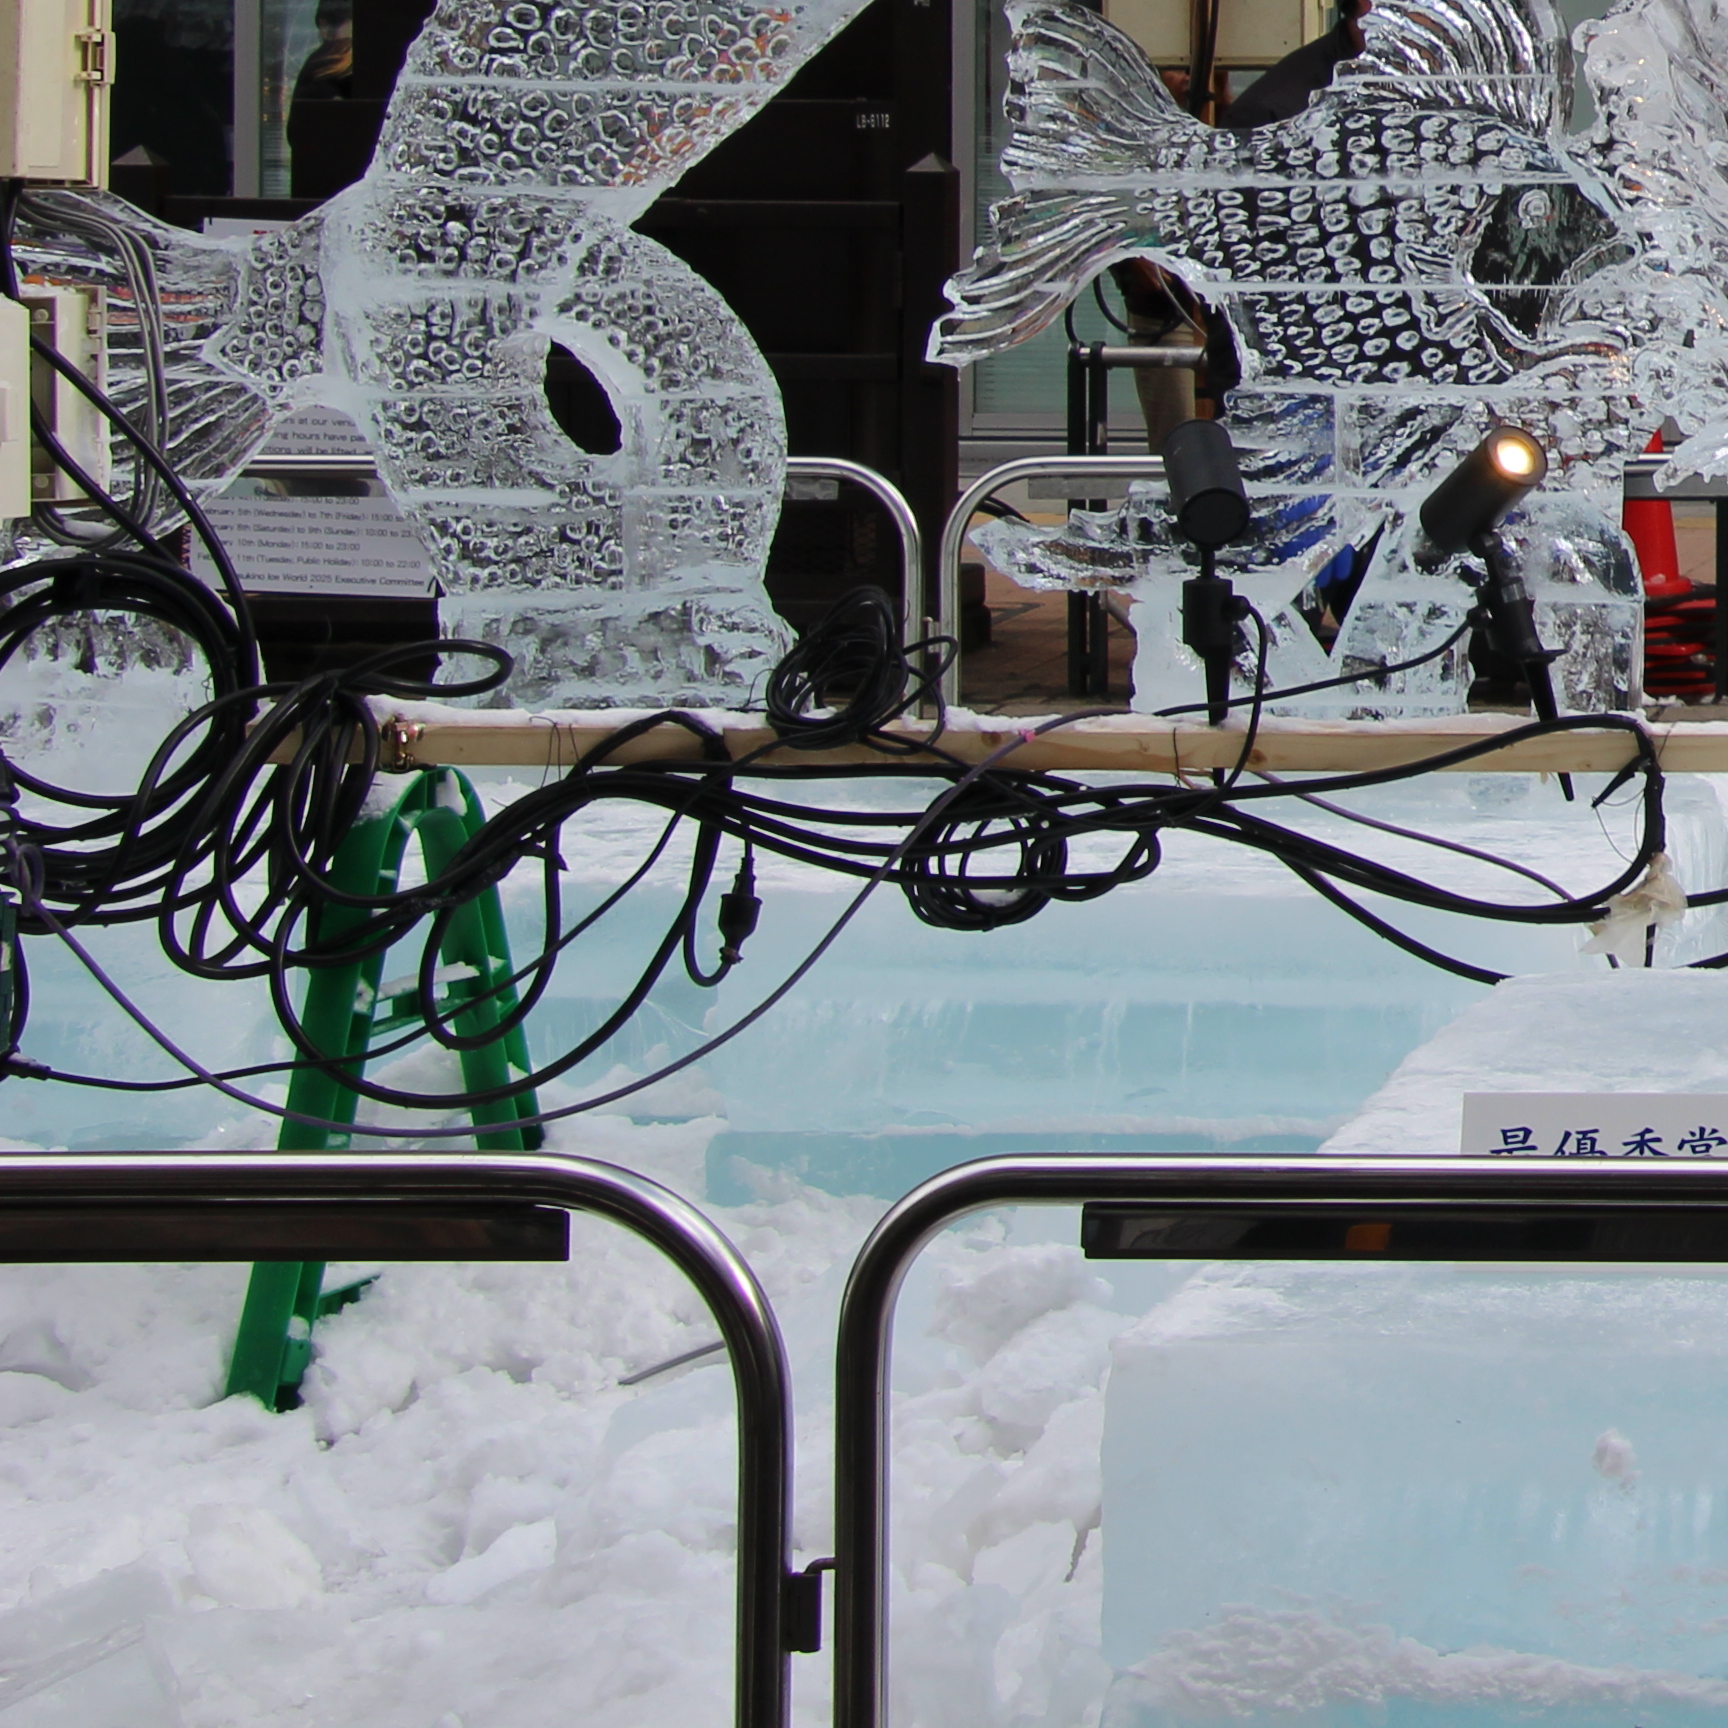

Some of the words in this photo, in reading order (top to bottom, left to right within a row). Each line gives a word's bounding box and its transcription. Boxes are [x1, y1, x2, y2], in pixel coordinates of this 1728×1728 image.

[292, 432, 320, 441] hours
[323, 433, 347, 442] have
[238, 572, 265, 581] sukino
[282, 574, 308, 582] World
[335, 575, 377, 584] Executive
[379, 577, 425, 586] Committee
